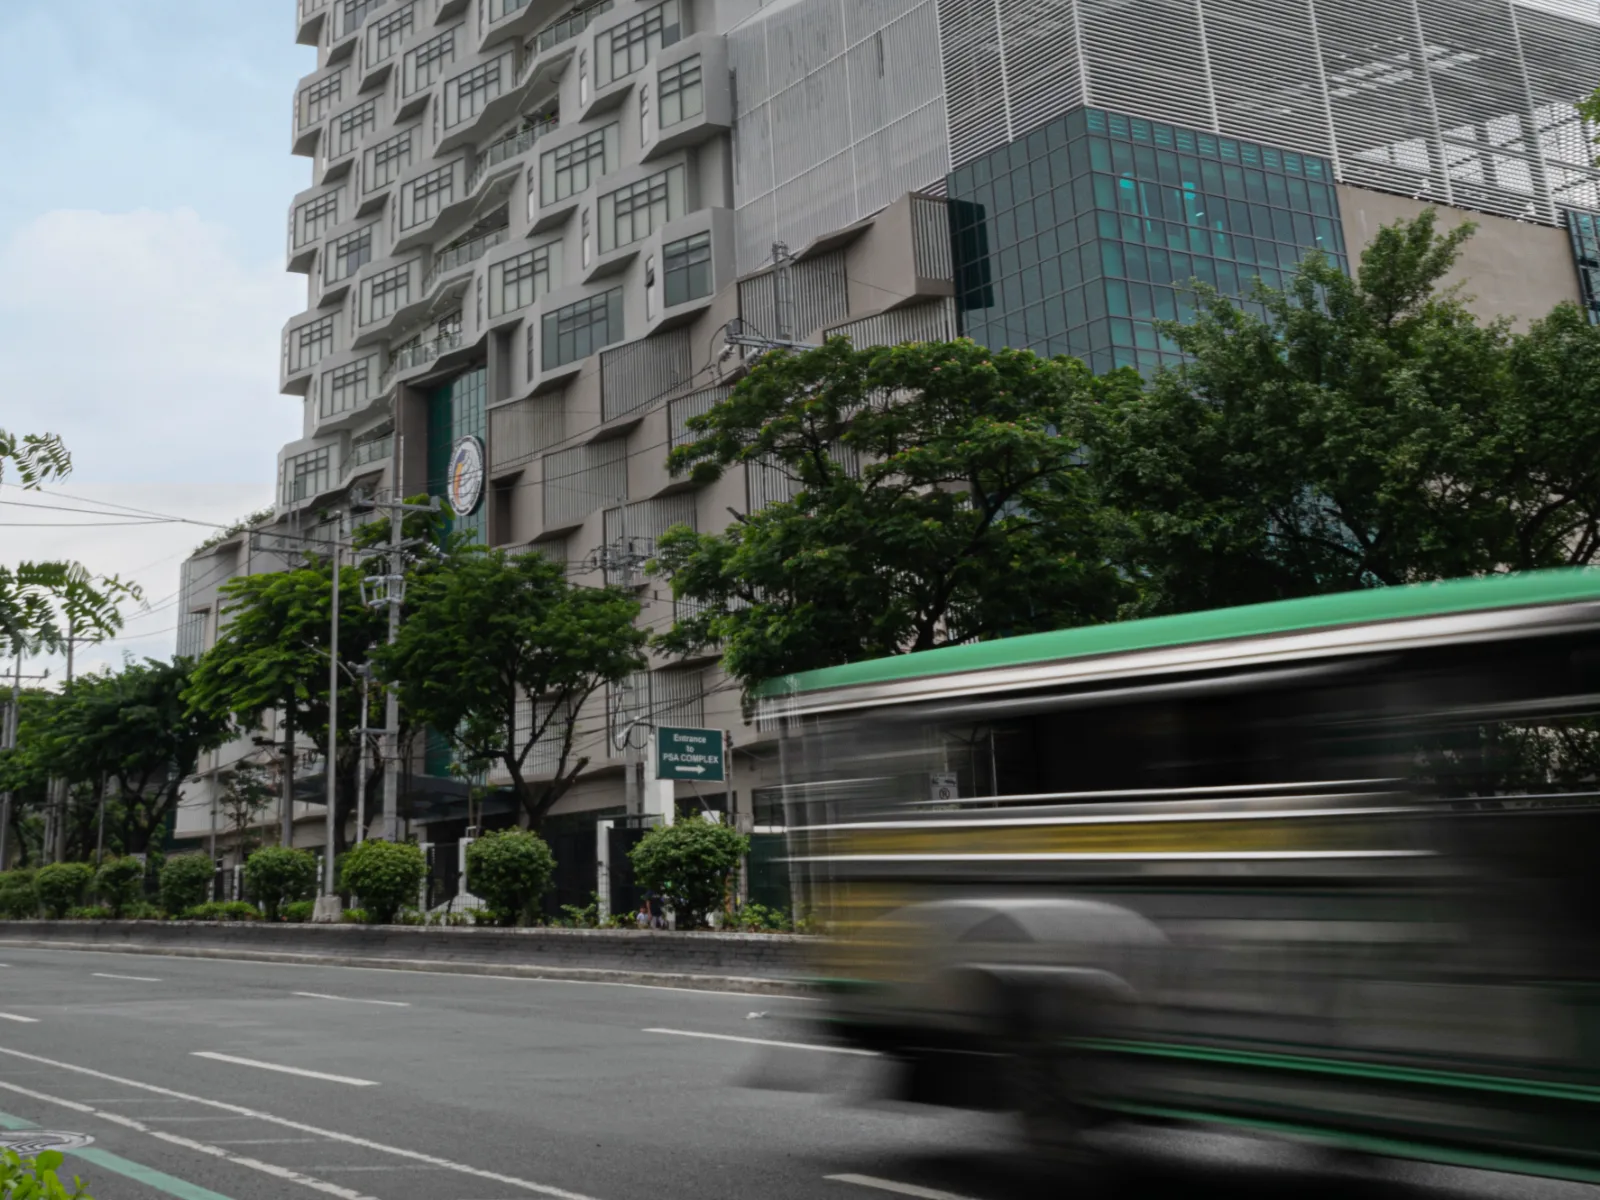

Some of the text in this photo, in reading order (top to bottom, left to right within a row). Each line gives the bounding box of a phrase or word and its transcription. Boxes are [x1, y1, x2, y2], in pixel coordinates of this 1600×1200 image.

[673, 733, 706, 744] Entrance
[686, 745, 695, 753] to
[663, 753, 719, 764] PSA COMPLEX
